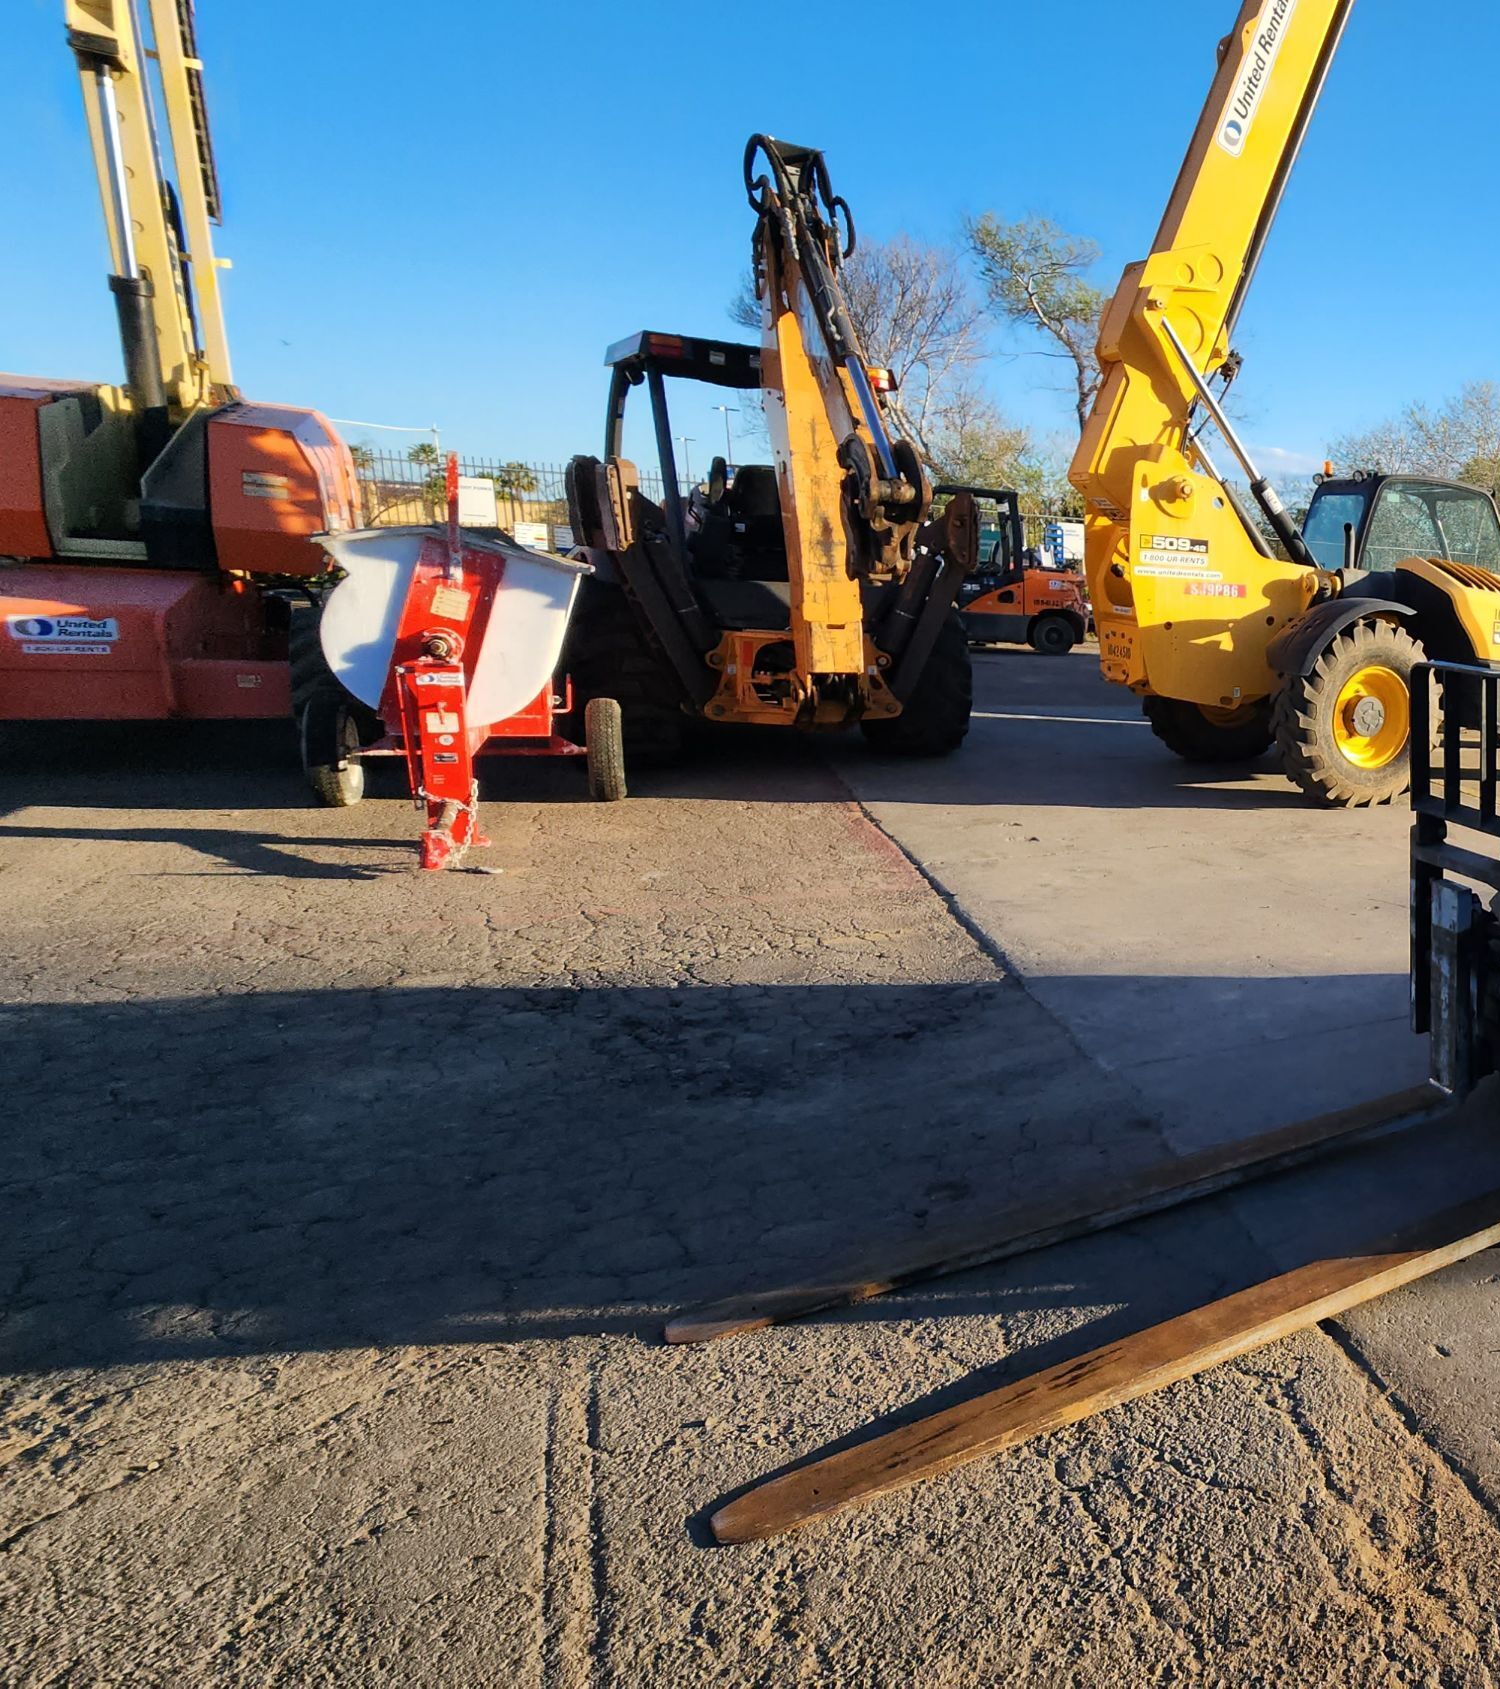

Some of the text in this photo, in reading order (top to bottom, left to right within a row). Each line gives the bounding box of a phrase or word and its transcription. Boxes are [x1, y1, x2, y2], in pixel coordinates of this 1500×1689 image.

[1233, 51, 1267, 120] United
[57, 619, 107, 629] United
[58, 629, 113, 637] Rentals
